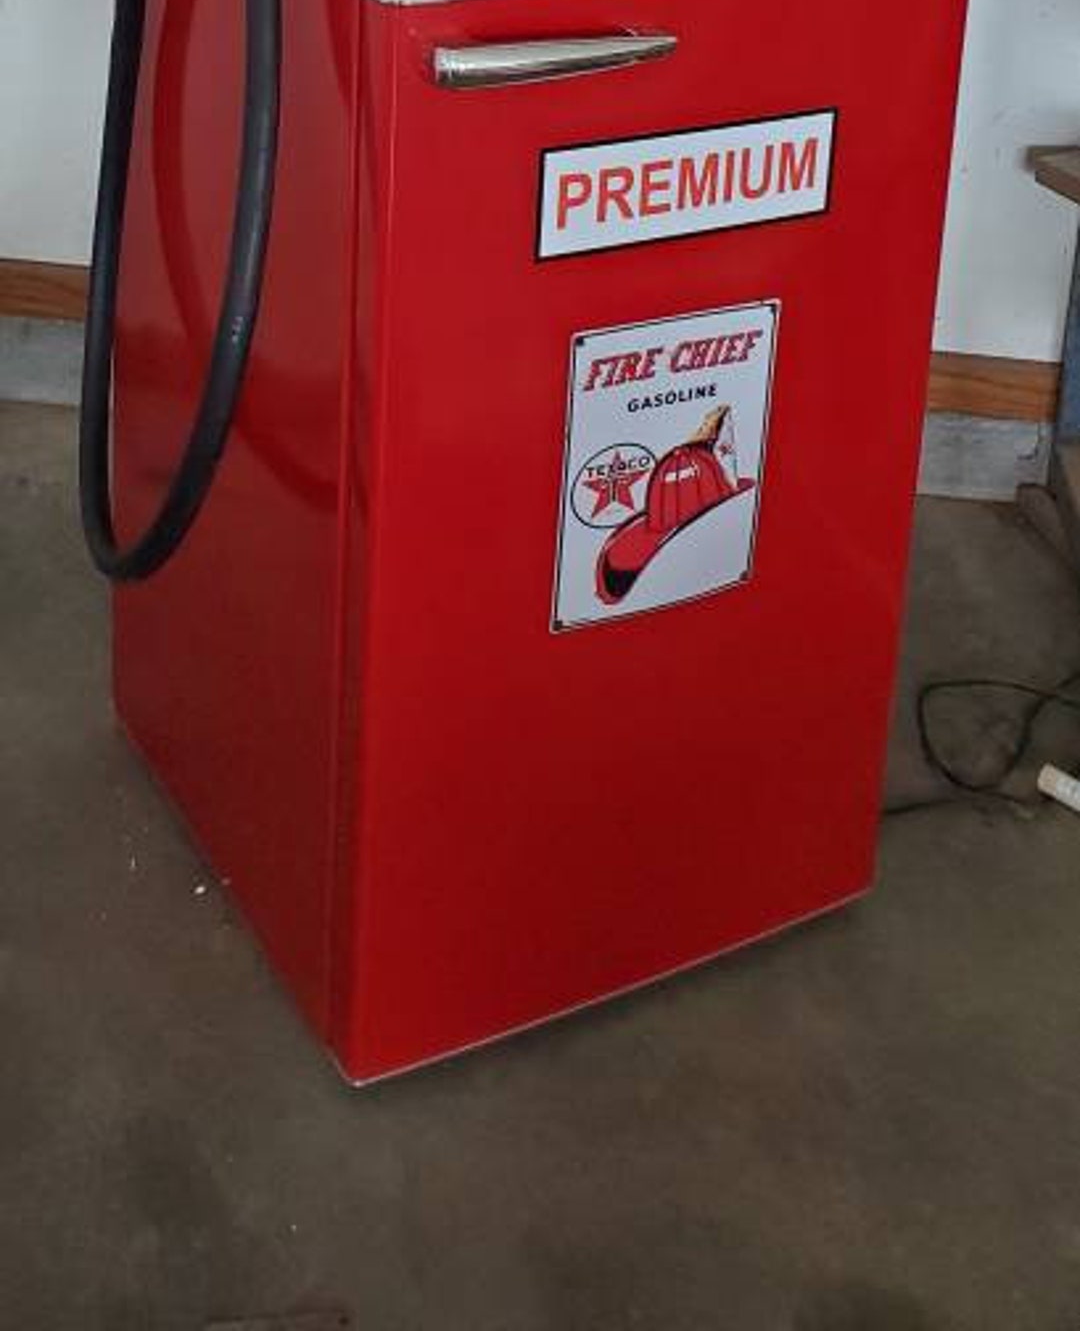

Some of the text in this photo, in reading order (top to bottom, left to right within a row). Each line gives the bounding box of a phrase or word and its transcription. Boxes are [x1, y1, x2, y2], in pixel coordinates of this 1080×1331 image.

[556, 136, 819, 230] PREMIUM
[583, 330, 764, 392] FIRE CHIEF
[627, 383, 717, 413] GASOLINE
[586, 456, 651, 478] TEXACO
